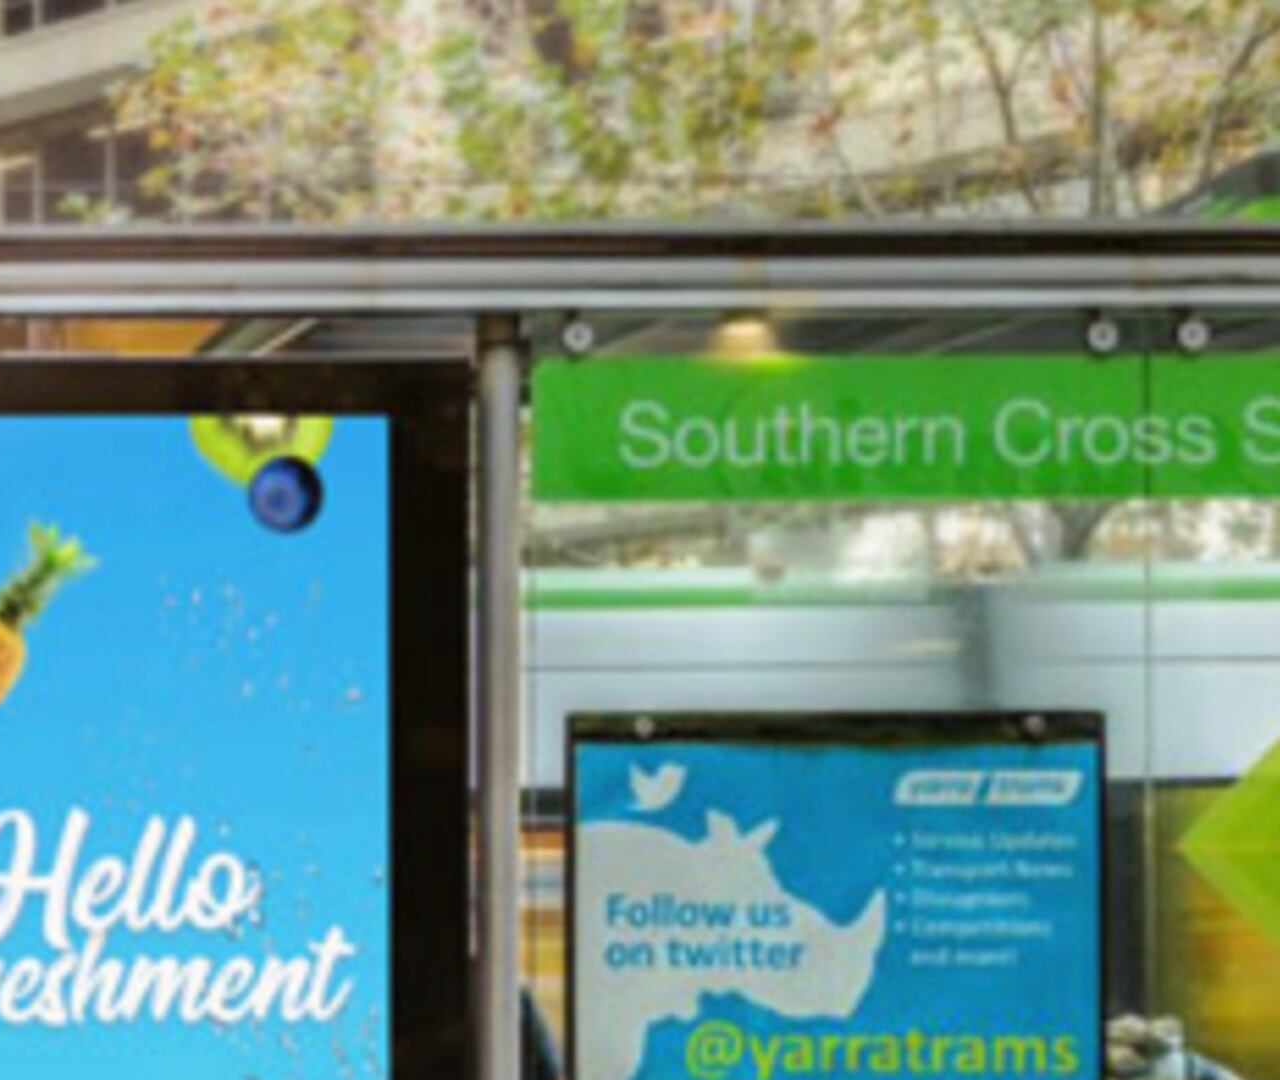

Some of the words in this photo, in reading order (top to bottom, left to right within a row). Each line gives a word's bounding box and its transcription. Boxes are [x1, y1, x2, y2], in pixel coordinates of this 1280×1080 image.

[617, 399, 965, 467] Southern
[992, 398, 1217, 464] Cross
[606, 893, 734, 929] Follow
[747, 903, 791, 930] us
[604, 942, 654, 969] on
[666, 936, 806, 970] twitter
